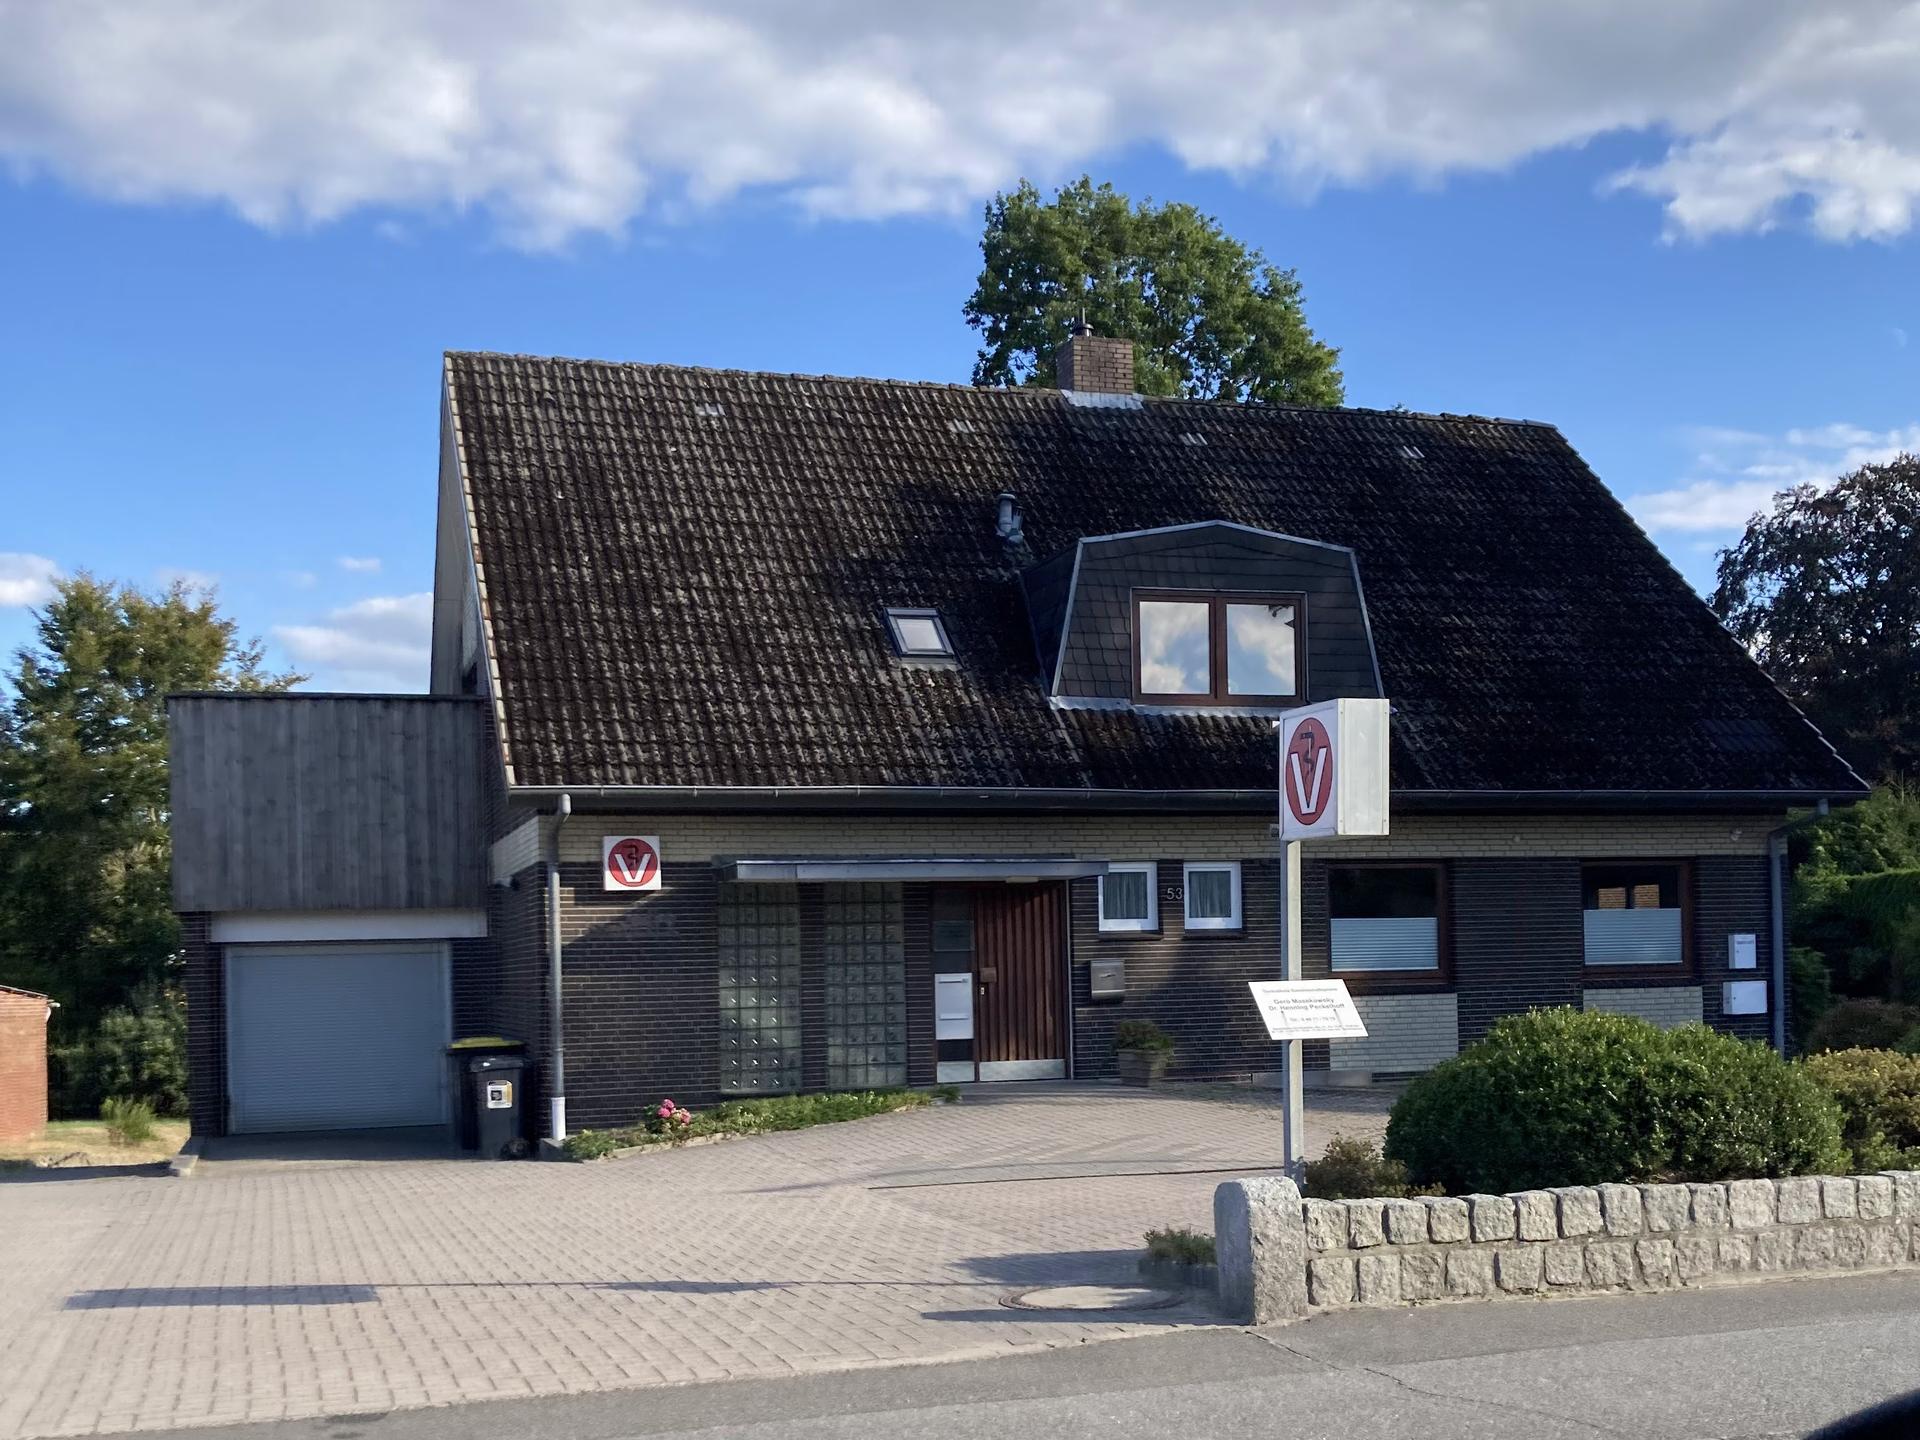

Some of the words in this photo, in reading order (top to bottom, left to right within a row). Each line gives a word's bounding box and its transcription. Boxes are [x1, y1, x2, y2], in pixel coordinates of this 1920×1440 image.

[1290, 746, 1328, 815] V
[614, 852, 652, 883] V
[1167, 887, 1183, 900] 53
